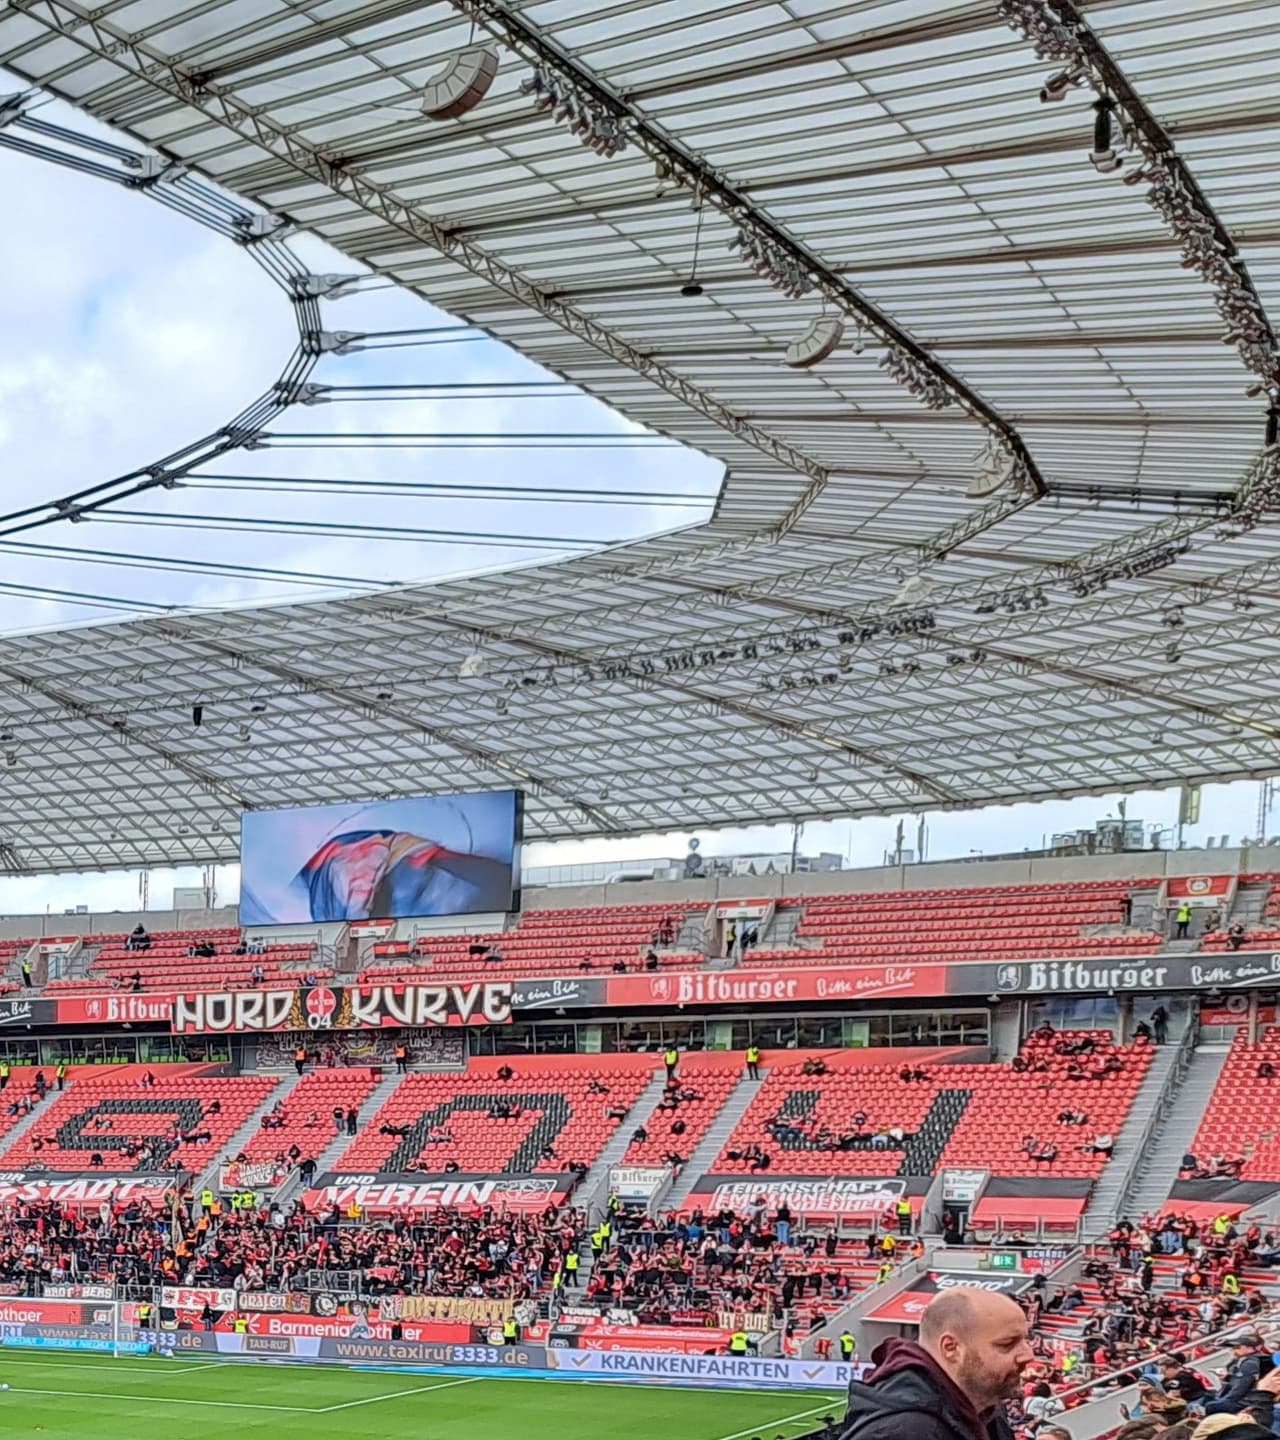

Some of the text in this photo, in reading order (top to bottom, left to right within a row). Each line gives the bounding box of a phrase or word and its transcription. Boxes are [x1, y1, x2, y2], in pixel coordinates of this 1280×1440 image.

[1025, 962, 1168, 991] Bitburger
[677, 977, 798, 1001] Bitburger
[107, 997, 172, 1020] Bitbur
[351, 984, 512, 1024] KURVE
[323, 1180, 497, 1206] VEREIN
[722, 1181, 885, 1195] LEIDENSCHAFT
[269, 1318, 423, 1341] Barmeniaother
[248, 1338, 290, 1351] TAXI-RUF
[336, 1343, 529, 1365] www.taxiruf3333.de
[600, 1353, 790, 1379] KRANKENFAHRTEN
